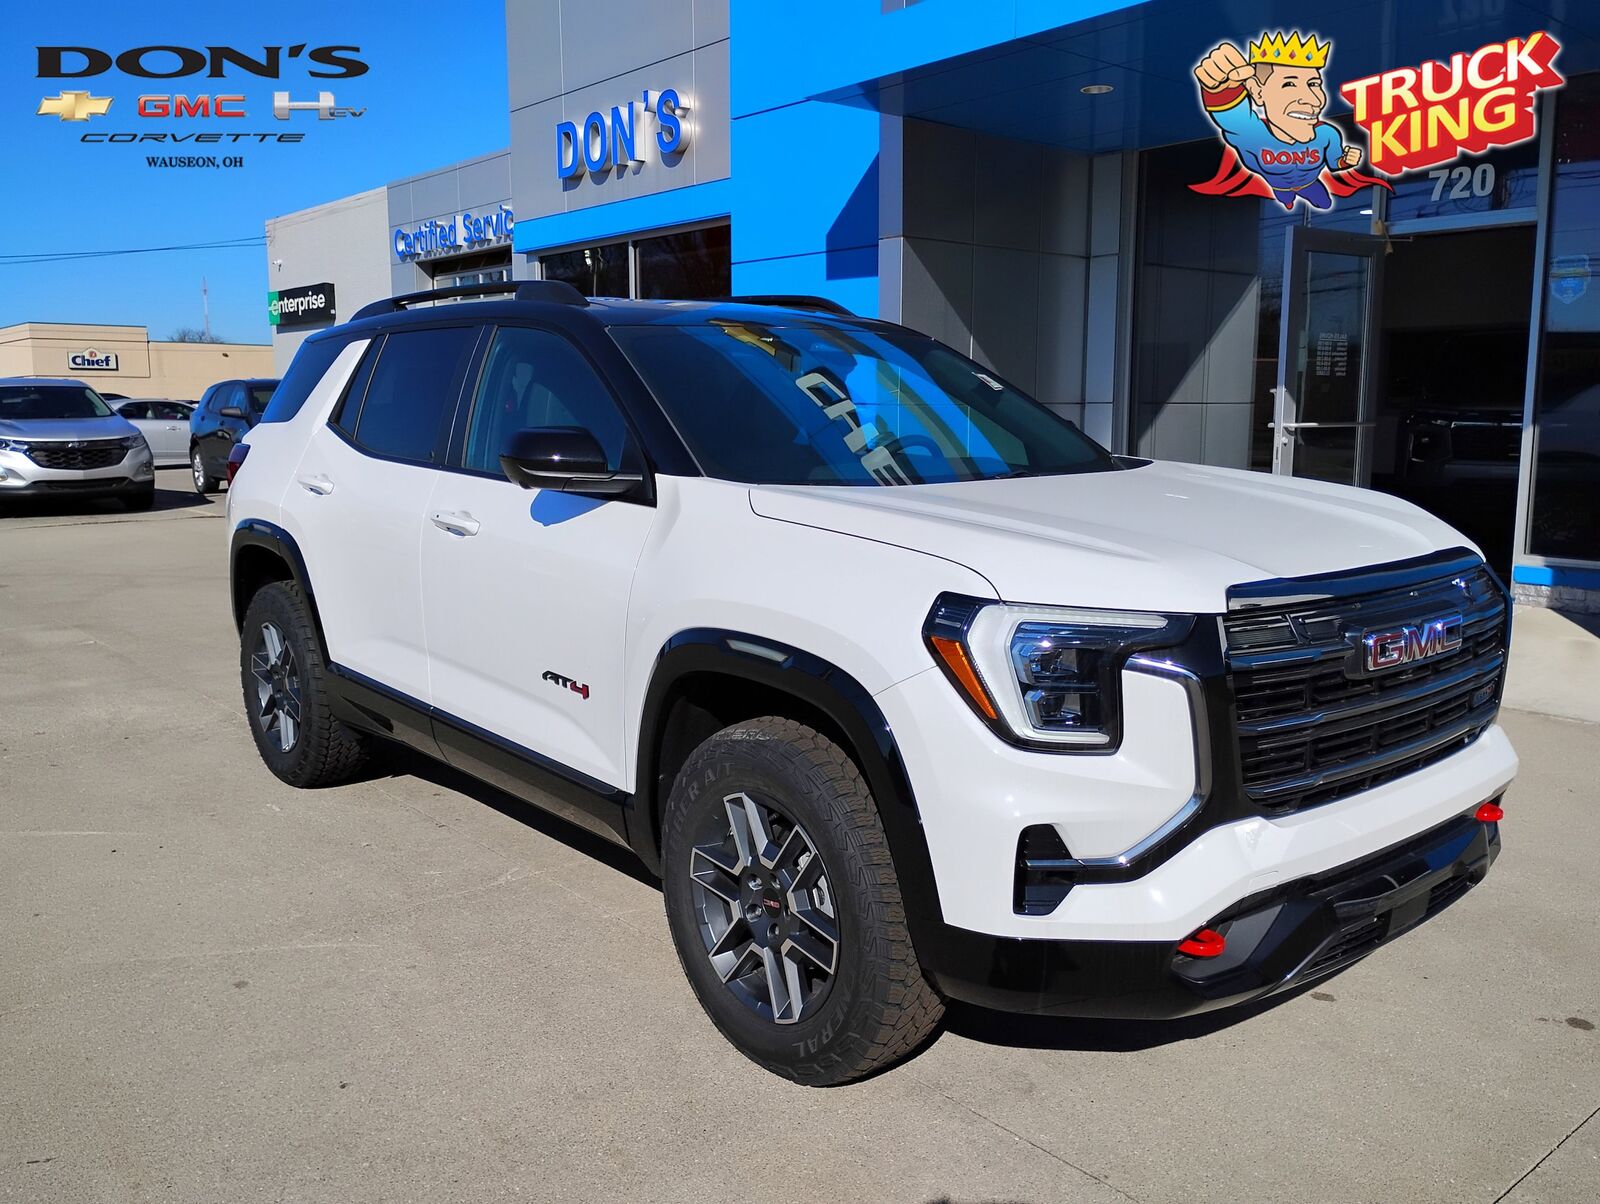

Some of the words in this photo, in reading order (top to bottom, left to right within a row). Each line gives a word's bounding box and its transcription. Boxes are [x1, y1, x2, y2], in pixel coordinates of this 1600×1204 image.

[556, 89, 685, 179] DON'S
[1428, 163, 1496, 202] 720
[394, 216, 459, 257] Certified
[269, 290, 326, 316] enterprise
[71, 354, 111, 367] Chief
[1366, 614, 1462, 671] GMC
